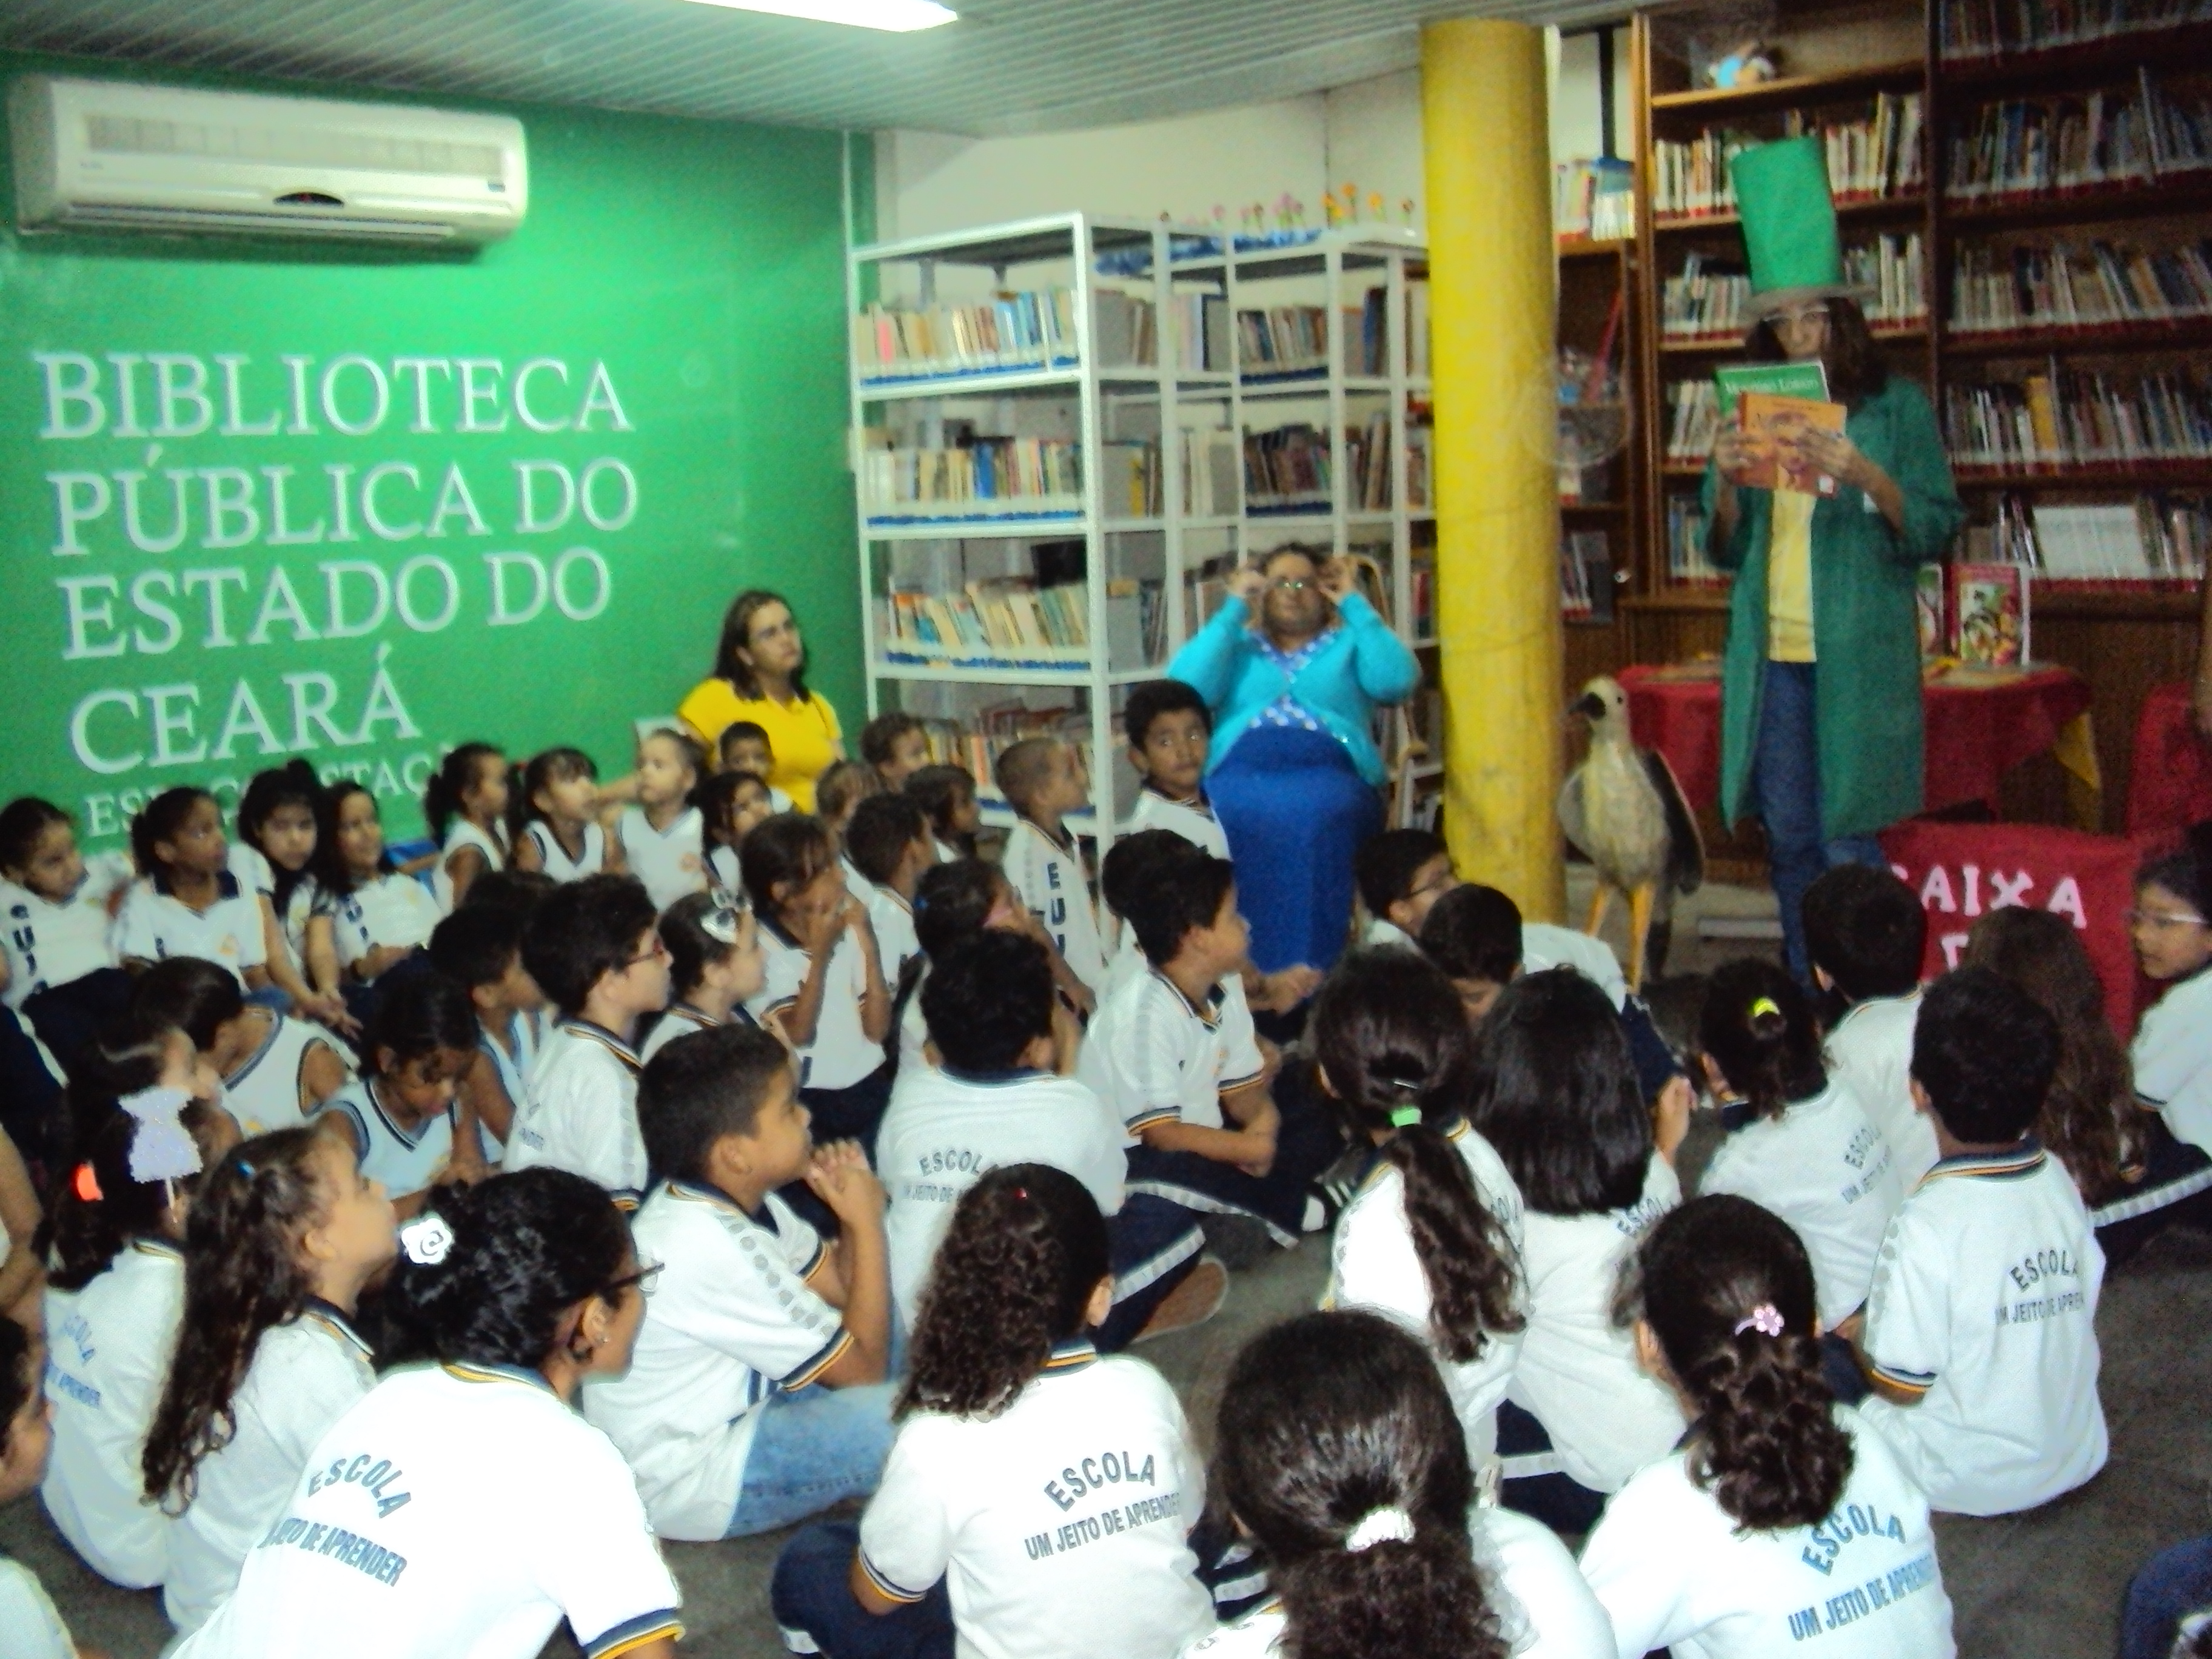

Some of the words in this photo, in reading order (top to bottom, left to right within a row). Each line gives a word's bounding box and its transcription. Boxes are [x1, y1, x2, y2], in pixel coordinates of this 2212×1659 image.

[33, 350, 635, 439] BIBLIOTECA
[46, 444, 492, 555] PÚBLICA
[512, 457, 638, 533] DO
[56, 555, 461, 660] ESTADO
[484, 547, 611, 626] DO
[71, 641, 423, 774] CEARÁ
[1889, 863, 2088, 930] AIXA
[919, 1149, 999, 1177] ESCOL
[307, 1453, 412, 1519] ESCOLA
[1043, 1450, 1155, 1513] ESCOLA
[299, 1522, 329, 1552] DE
[317, 1526, 408, 1587] APRENDER
[1024, 1532, 1054, 1561] UM
[1056, 1516, 1101, 1553] JEITO
[1101, 1508, 1125, 1536] DE
[1801, 1504, 1906, 1577] ESCOLA
[1788, 1606, 1823, 1641] UM
[1825, 1586, 1870, 1631] JEITO
[1866, 1577, 1891, 1610] DE
